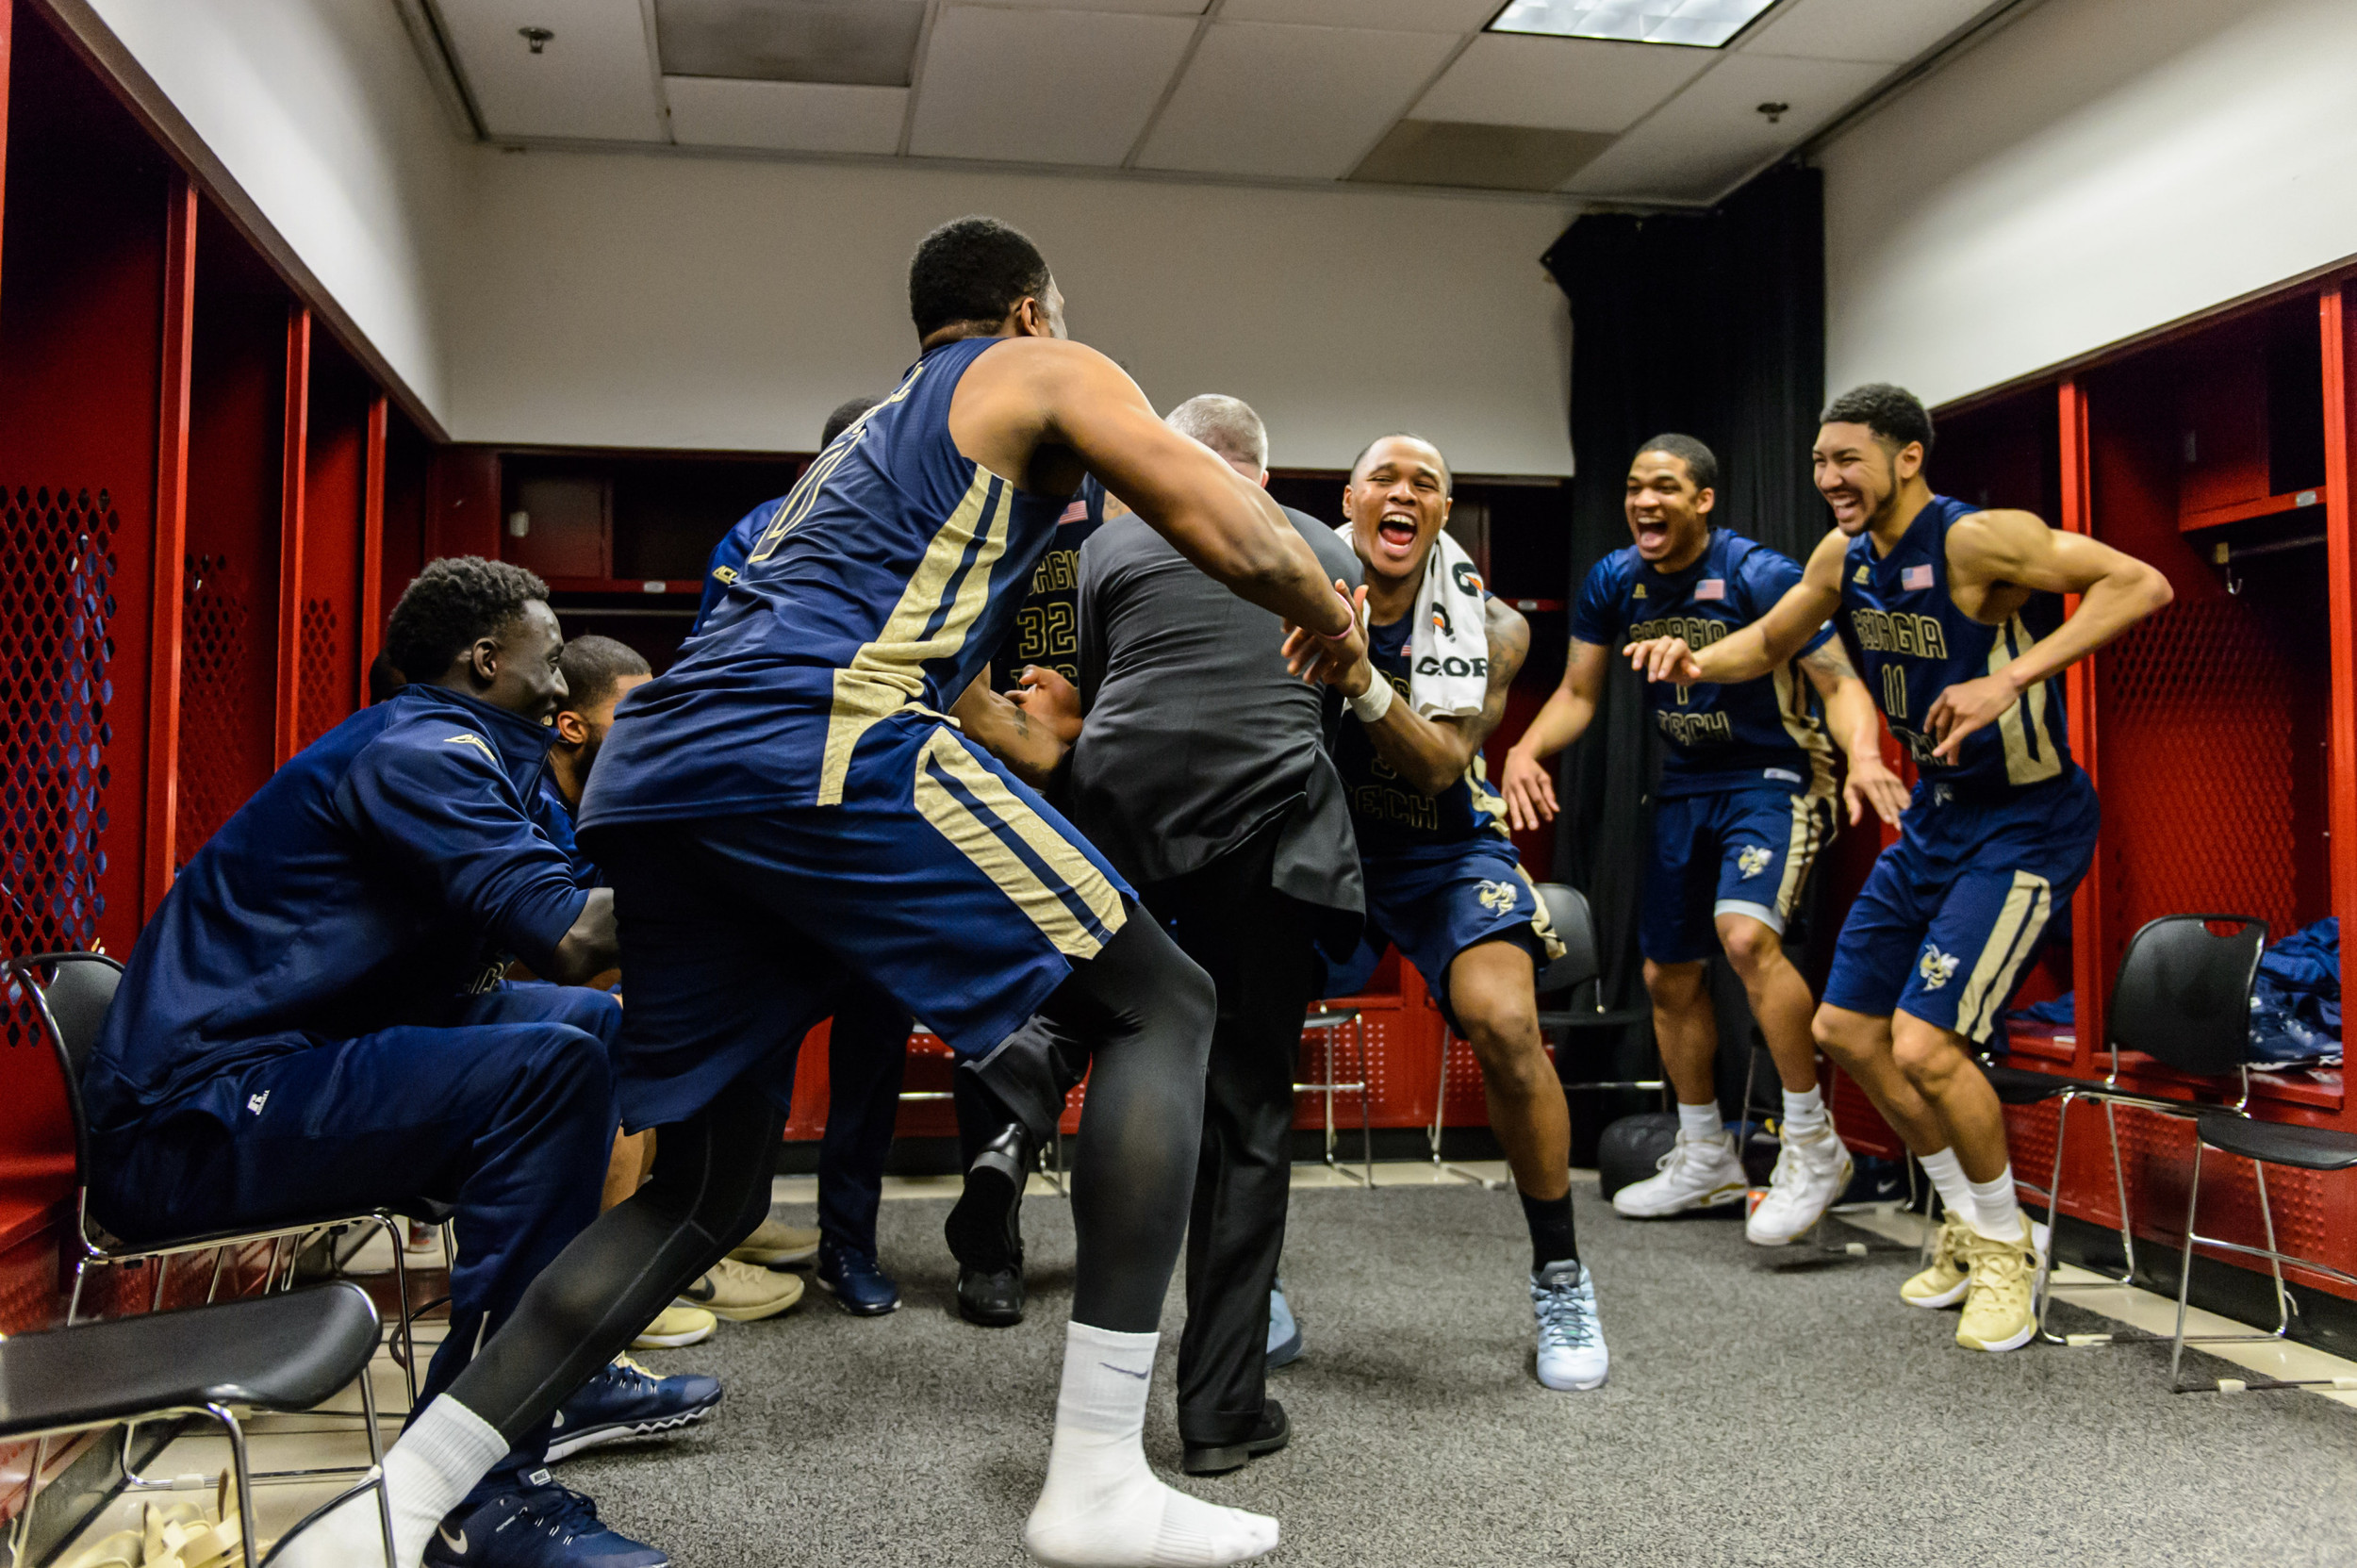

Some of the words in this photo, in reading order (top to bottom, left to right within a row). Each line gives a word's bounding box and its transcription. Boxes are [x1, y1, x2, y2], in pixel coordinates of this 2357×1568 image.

[1015, 601, 1077, 659] 32
[1882, 663, 1907, 718] 11
[1350, 784, 1439, 831] ECH
